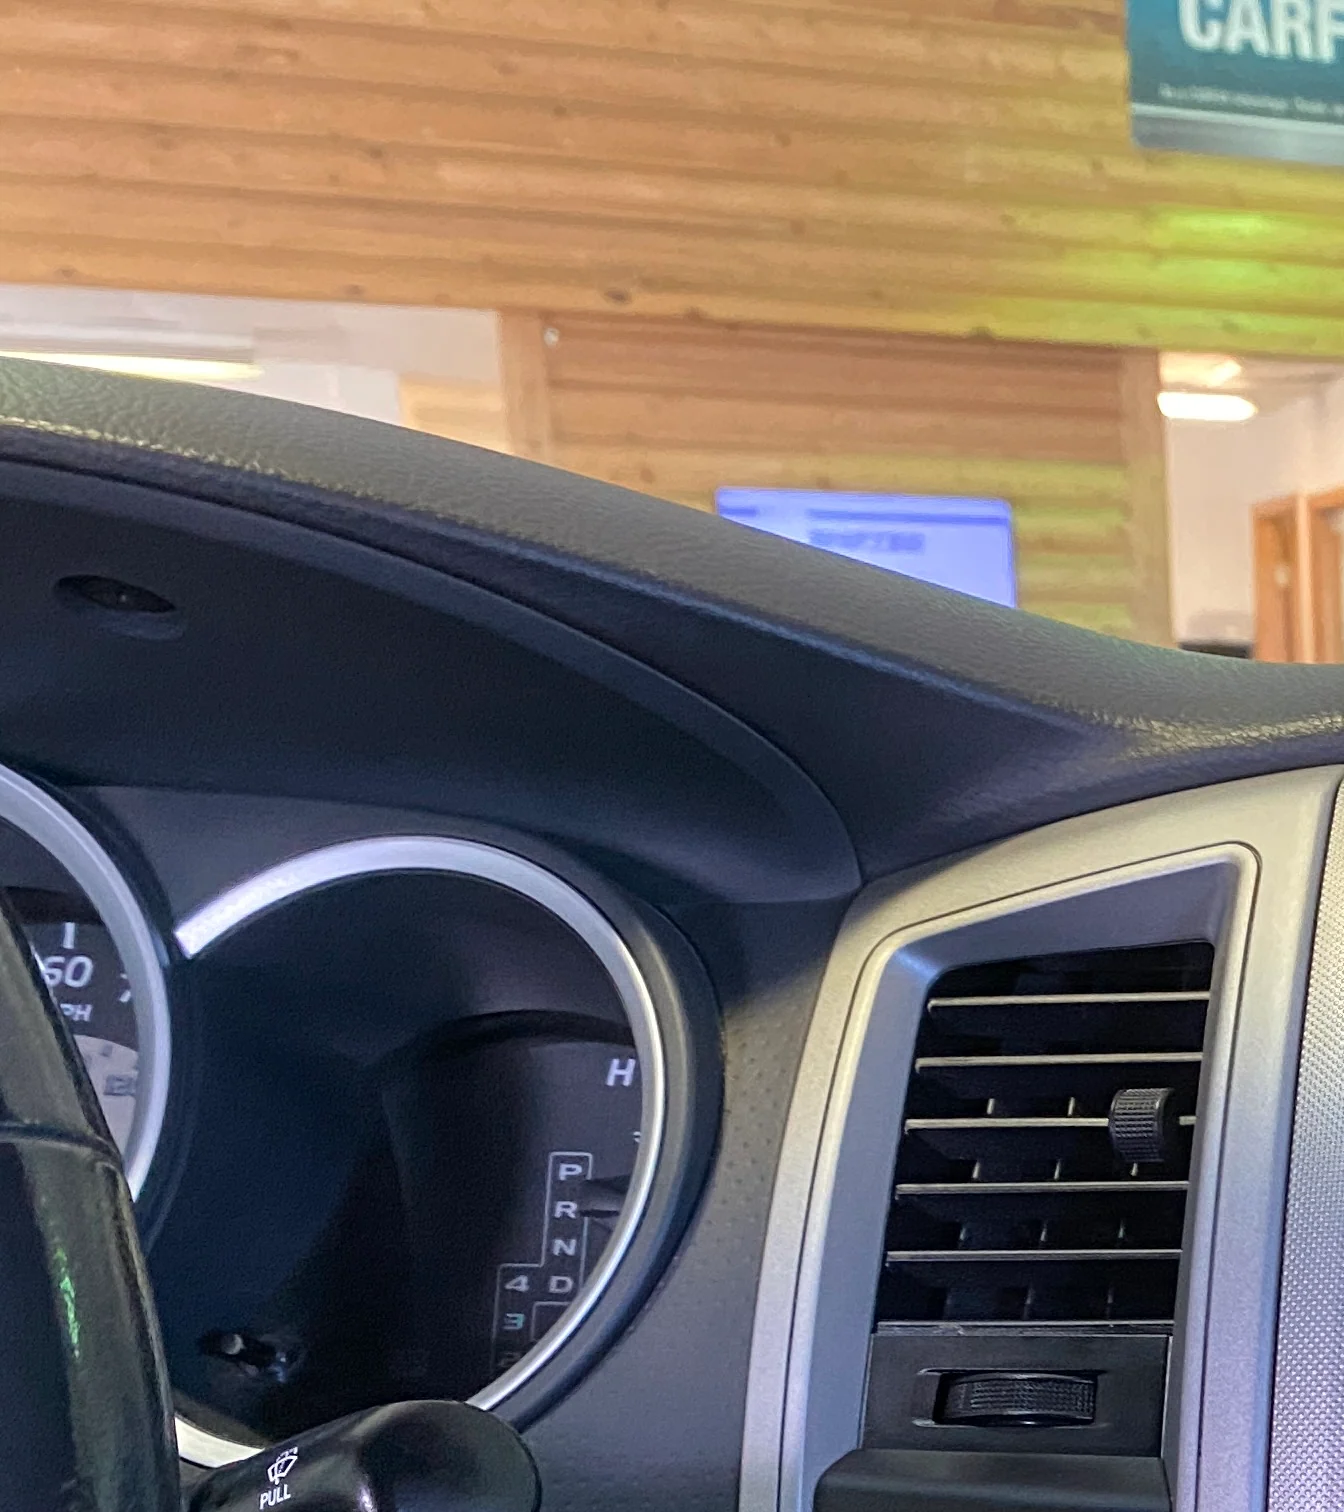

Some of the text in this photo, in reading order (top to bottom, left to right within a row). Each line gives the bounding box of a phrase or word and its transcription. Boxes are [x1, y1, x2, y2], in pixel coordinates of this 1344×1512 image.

[60, 1003, 92, 1022] PH
[606, 1058, 636, 1087] H
[558, 1163, 582, 1181] P
[554, 1201, 578, 1219] R
[553, 1239, 577, 1256] N
[505, 1275, 574, 1293] 4 D
[503, 1313, 525, 1330] 3
[260, 1484, 291, 1510] PULL
